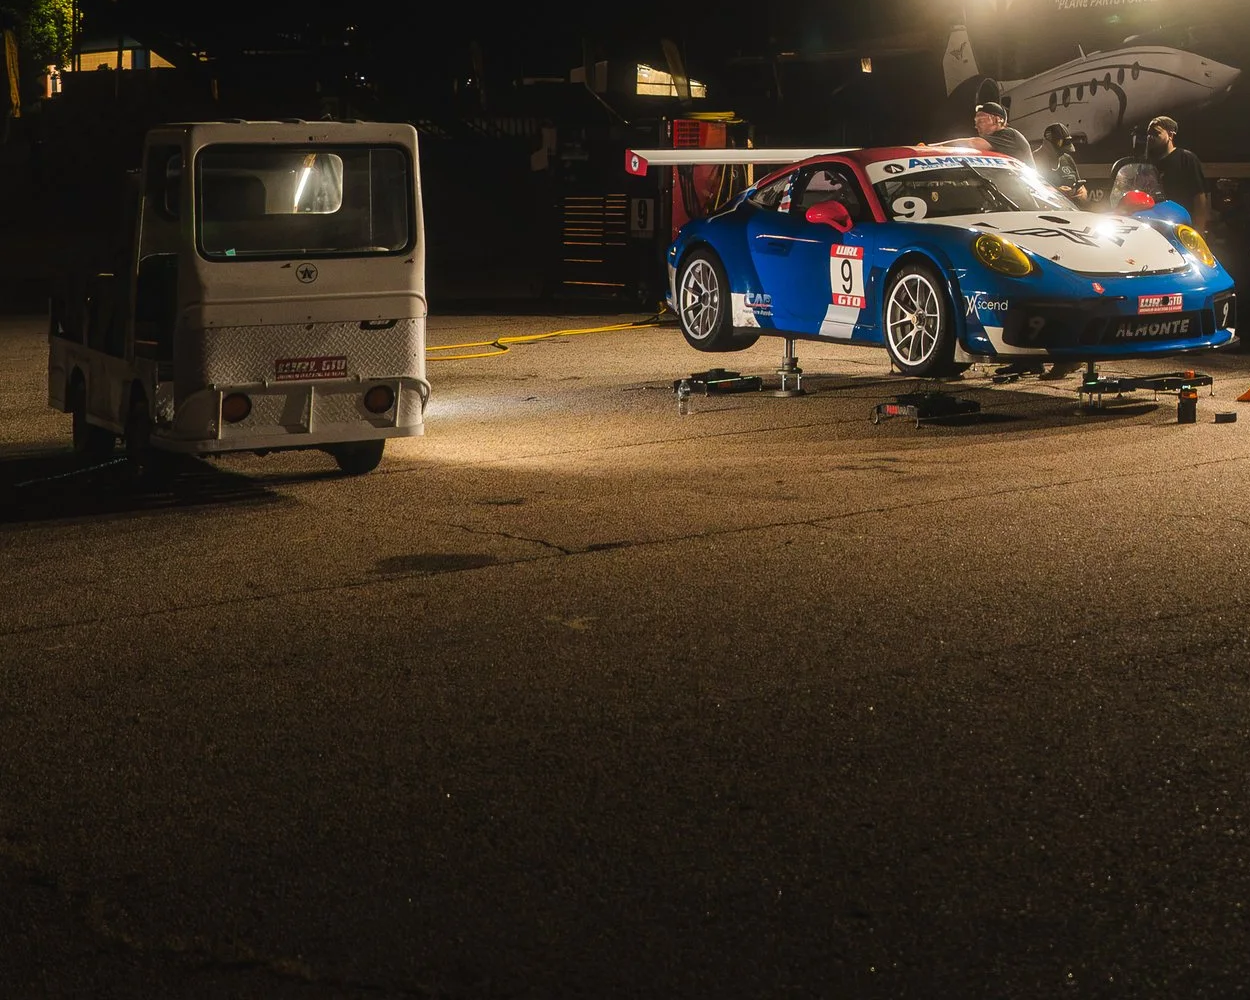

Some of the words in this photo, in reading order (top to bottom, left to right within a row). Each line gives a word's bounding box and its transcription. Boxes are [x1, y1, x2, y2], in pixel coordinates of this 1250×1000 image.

[908, 156, 1007, 169] ALMONTE
[637, 199, 648, 229] 9
[892, 196, 928, 222] 9
[836, 246, 859, 257] WRL
[841, 259, 853, 294] 9
[837, 295, 861, 307] GTO
[1221, 302, 1229, 328] 9
[1027, 315, 1046, 341] 9
[1115, 319, 1190, 338] ALMONTE
[321, 359, 346, 371] GTO
